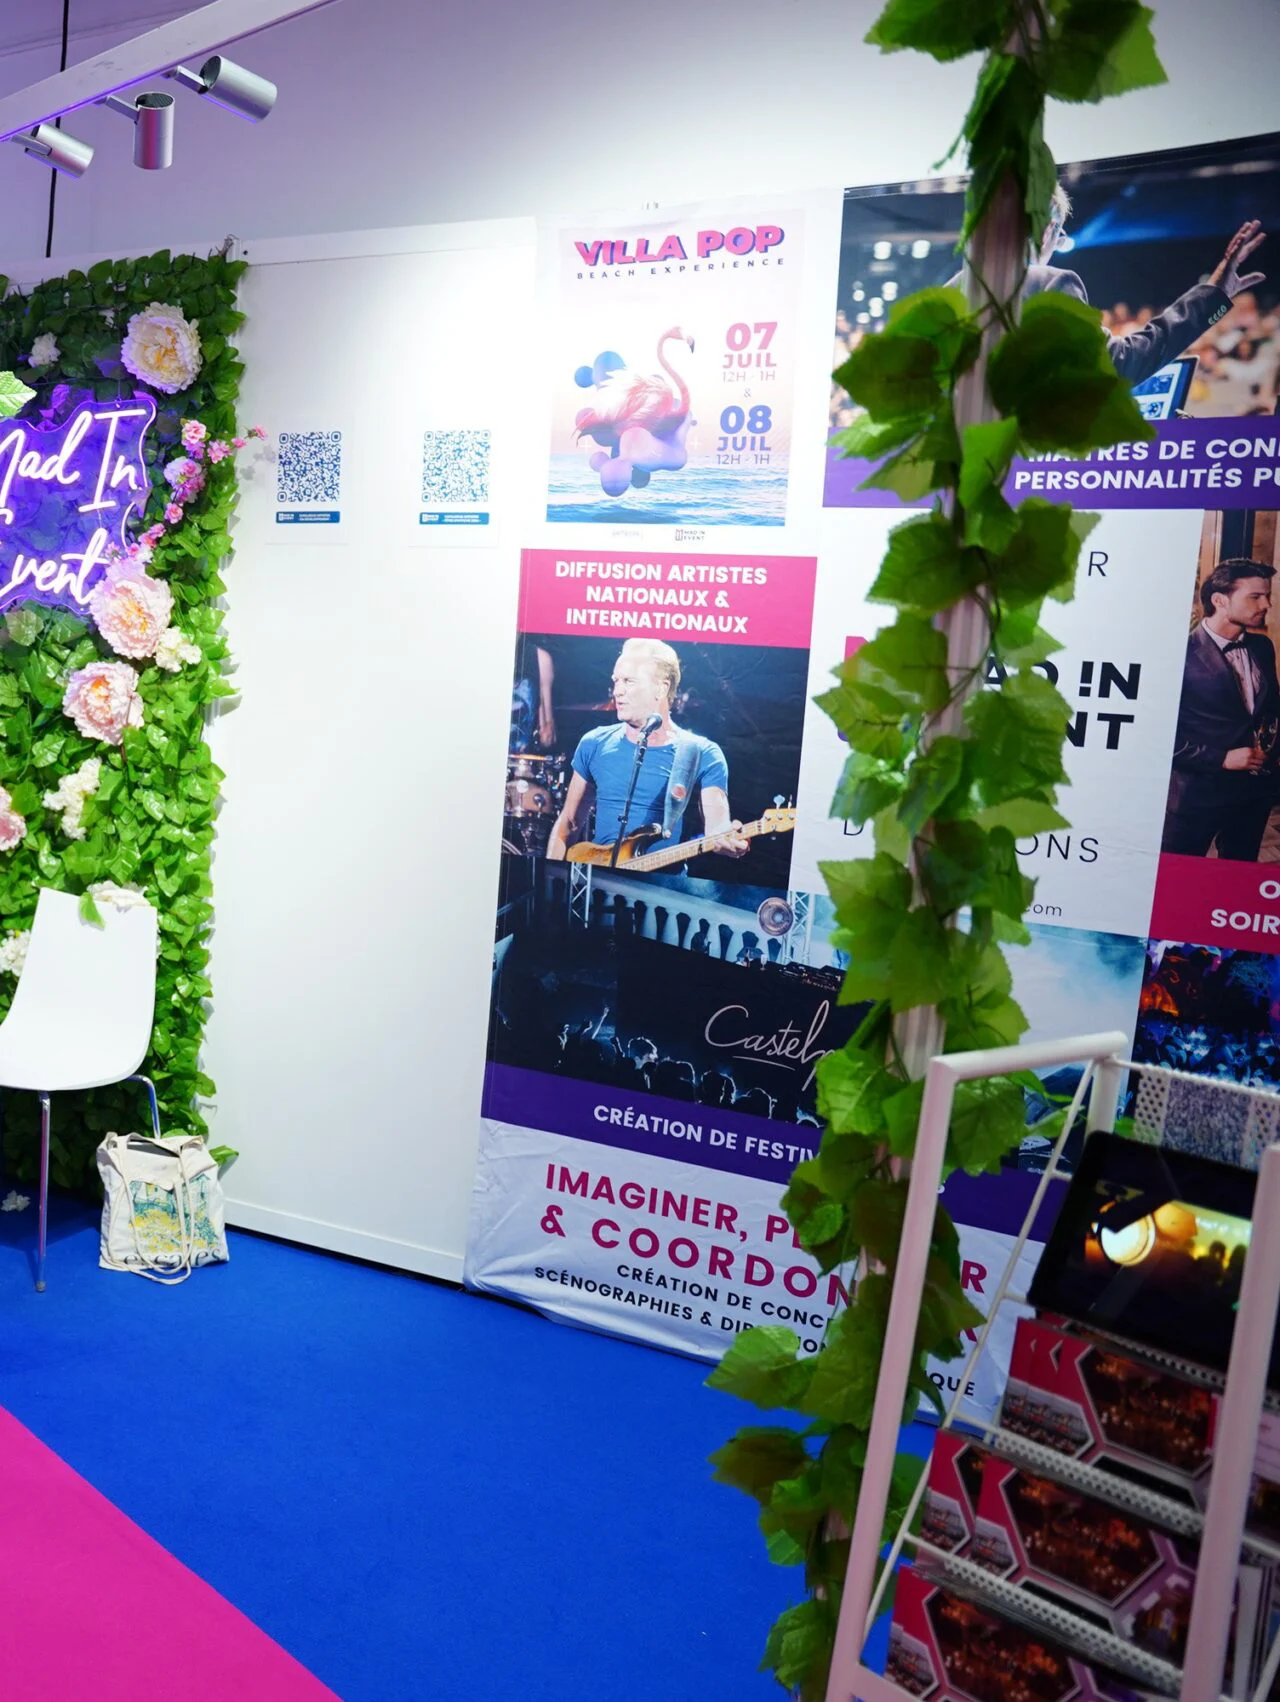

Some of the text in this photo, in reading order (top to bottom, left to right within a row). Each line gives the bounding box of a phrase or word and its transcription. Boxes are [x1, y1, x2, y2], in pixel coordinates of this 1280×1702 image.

[574, 225, 785, 266] VILLA POP
[577, 258, 784, 280] BEACH EXPERIENCE
[725, 321, 778, 352] 07
[722, 352, 777, 369] JUIL
[722, 371, 746, 382] 12H
[743, 387, 752, 399] &
[719, 404, 773, 435] 08
[716, 436, 772, 452] JUIL
[1158, 440, 1196, 460] DE
[1205, 438, 1280, 459] CON
[78, 408, 147, 513] In
[716, 454, 741, 465] 12H
[754, 454, 770, 465] 1H
[1014, 463, 1243, 490] PERSONNALITÉS
[555, 560, 768, 585] DIFFUSION ARTISTES
[586, 585, 730, 608] NATIONAUX &
[566, 608, 749, 634] INTERNATIONAUX
[593, 1105, 703, 1143] CRÉATION
[709, 1128, 738, 1151] DE
[546, 1163, 748, 1243] IMAGINER,
[540, 1204, 566, 1238] &
[534, 1265, 693, 1321] SCÉNOGRAPHIES
[700, 1311, 713, 1326] &
[617, 1263, 719, 1303] CRÉATION
[727, 1292, 753, 1311] DE
